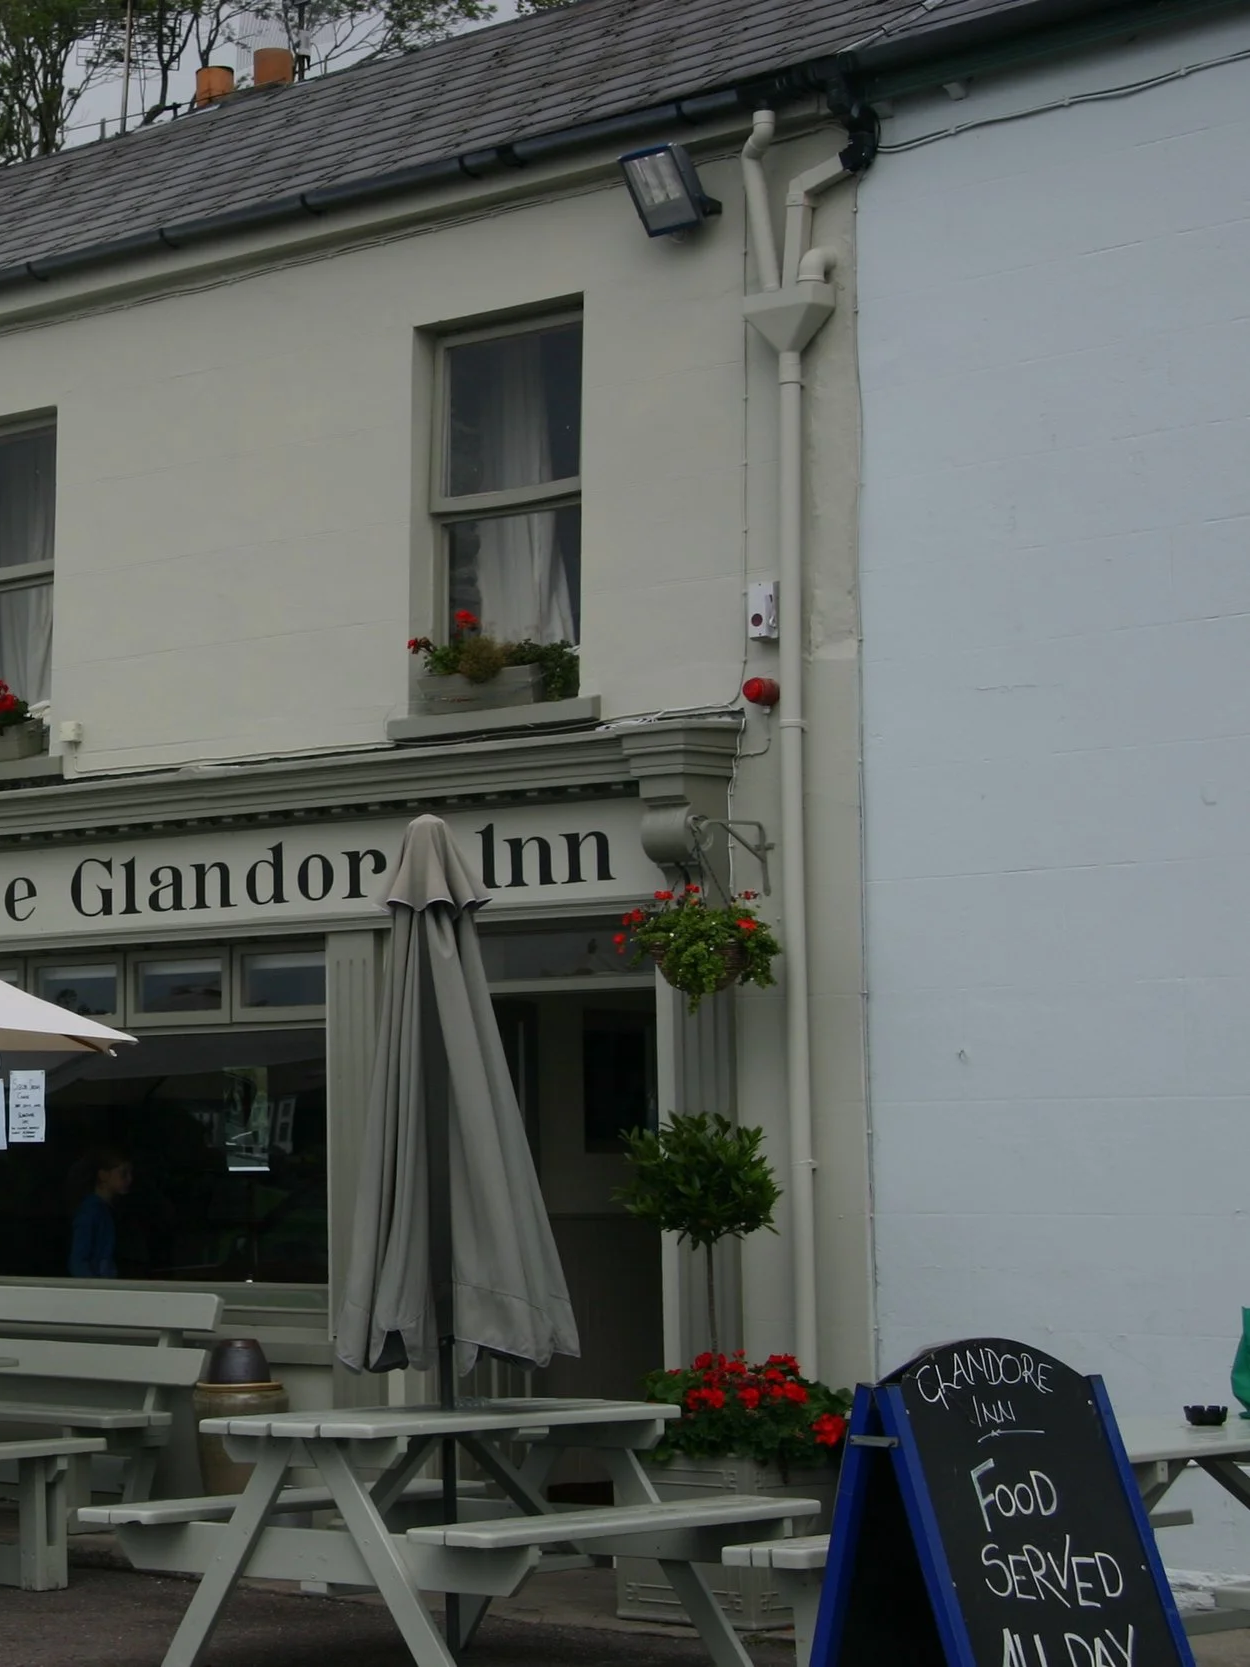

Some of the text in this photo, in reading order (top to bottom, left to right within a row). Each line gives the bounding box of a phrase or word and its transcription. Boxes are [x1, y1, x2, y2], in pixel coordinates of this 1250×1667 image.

[71, 840, 387, 917] Glandor
[474, 823, 617, 889] Inn
[916, 1347, 1054, 1410] GLANDORE
[972, 1395, 1016, 1427] INN
[981, 1534, 1124, 1608] SERVED
